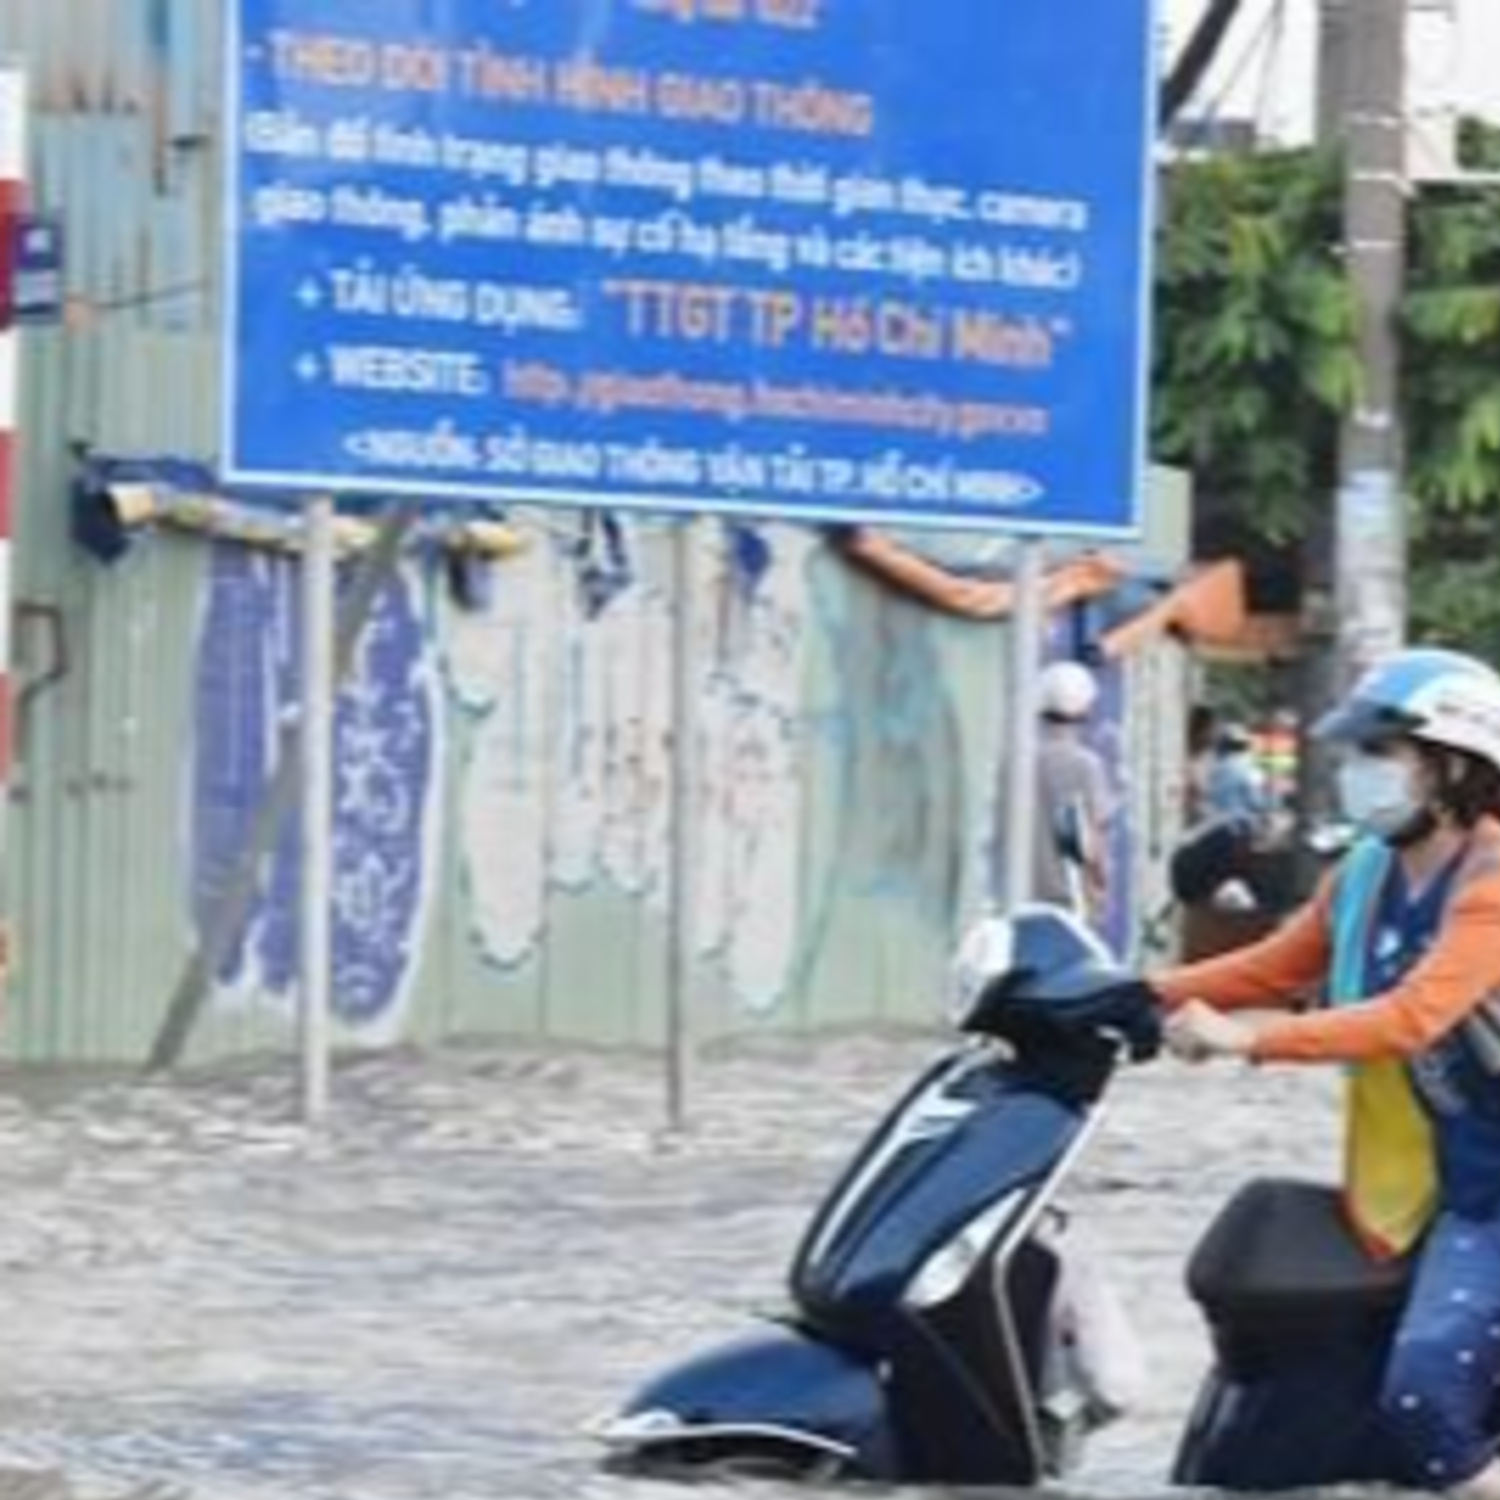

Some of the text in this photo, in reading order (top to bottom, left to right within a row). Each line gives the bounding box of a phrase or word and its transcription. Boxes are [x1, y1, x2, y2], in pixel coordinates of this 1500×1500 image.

[269, 31, 373, 85] THEO
[655, 72, 744, 122] GIAO
[751, 75, 873, 137] THÔNG
[750, 289, 797, 346] TP
